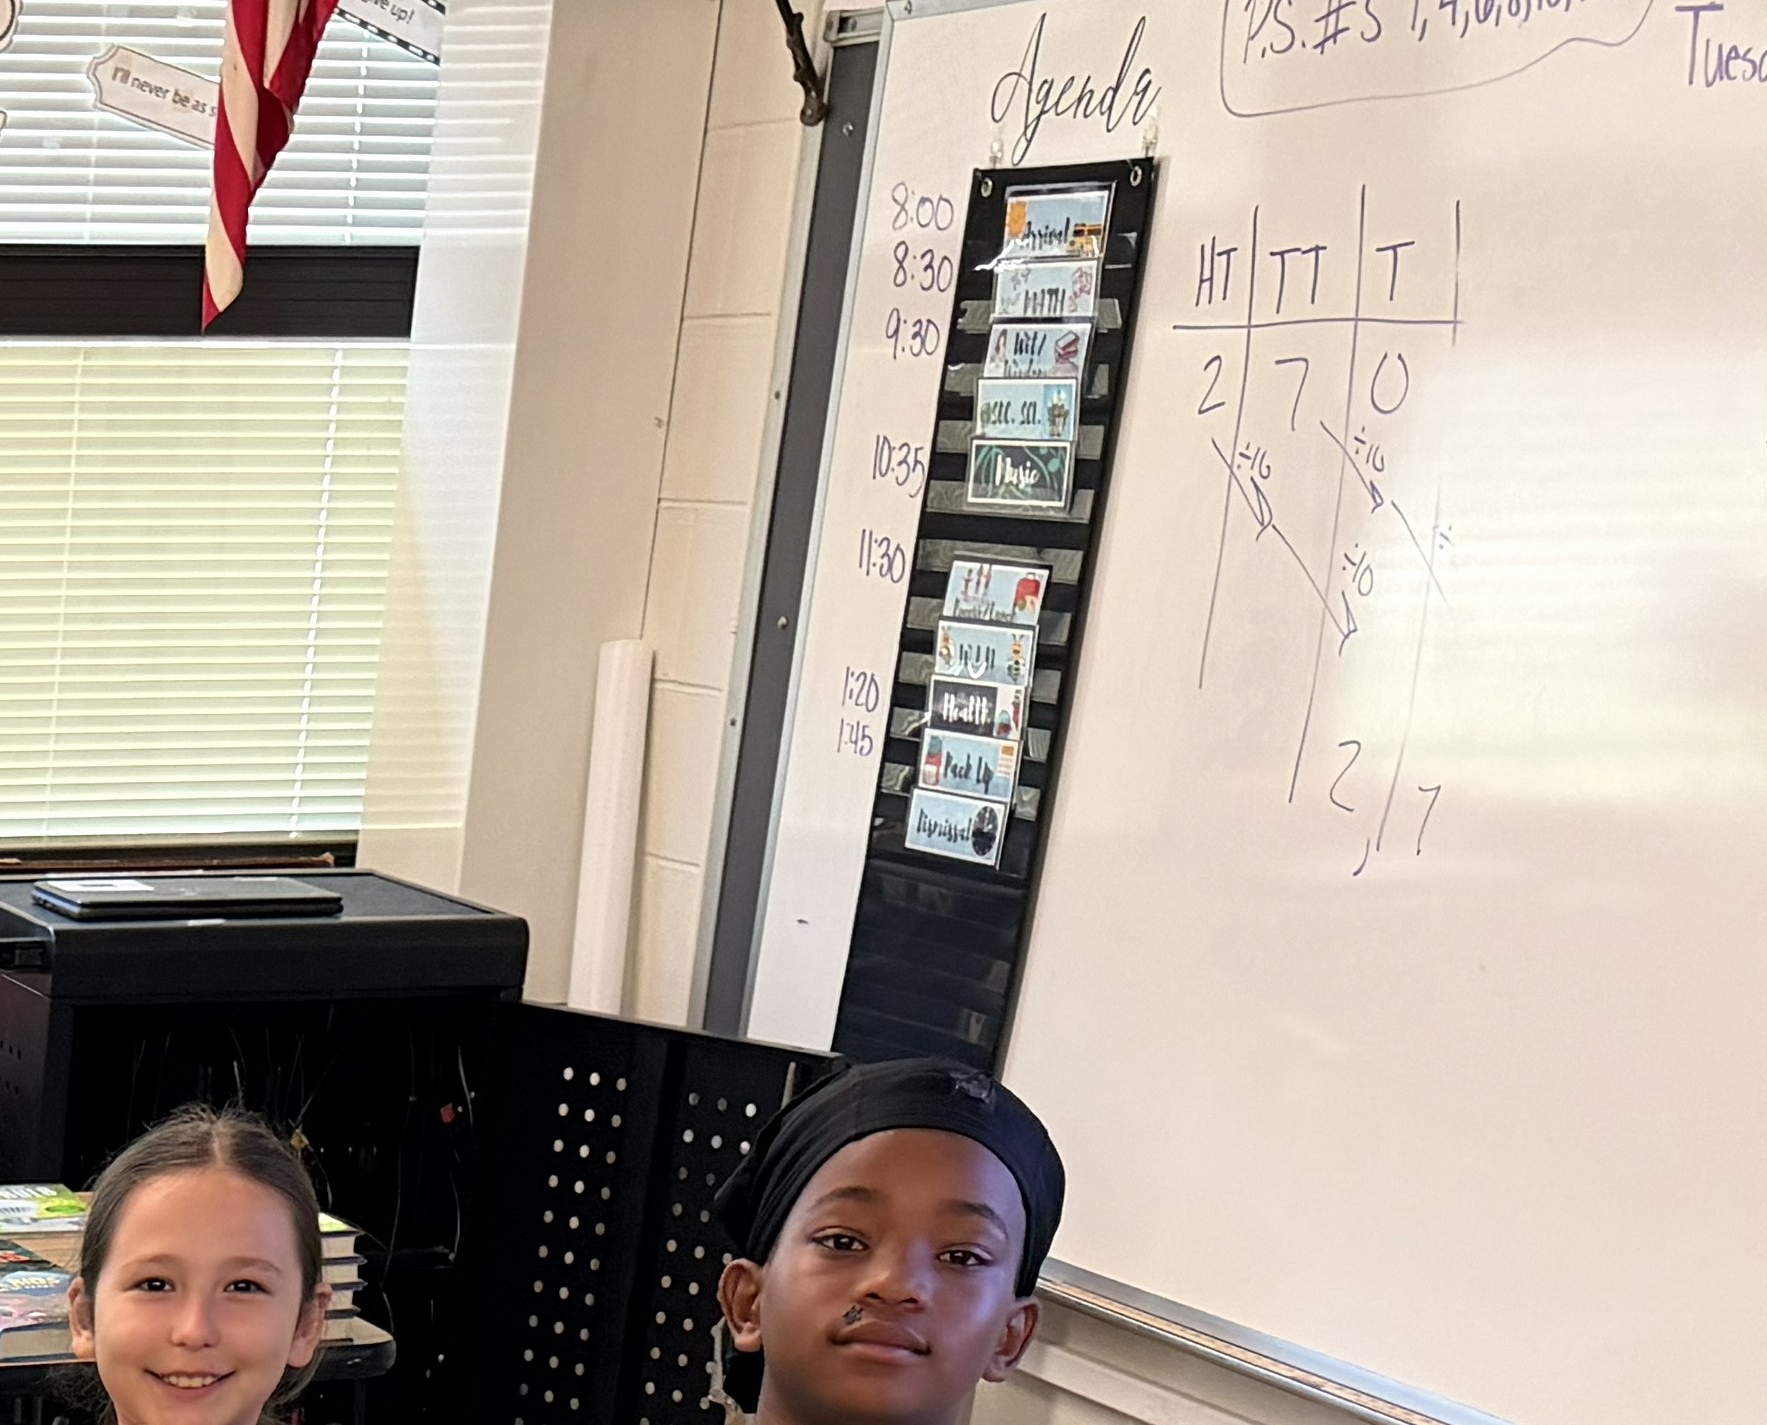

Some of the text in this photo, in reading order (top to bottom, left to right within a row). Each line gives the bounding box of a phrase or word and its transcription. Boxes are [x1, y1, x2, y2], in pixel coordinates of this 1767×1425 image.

[991, 12, 1162, 166] Agenda
[892, 181, 954, 231] 8:00
[893, 240, 954, 292] 8:30
[1195, 235, 1416, 314] HT TT T
[886, 307, 939, 359] 9:30
[1198, 351, 1410, 431] 2 7 0
[872, 435, 926, 497] 10:35
[995, 455, 1041, 489] Music
[859, 529, 906, 583] 11:30
[842, 667, 880, 713] 1:20
[837, 718, 873, 756] 1:45
